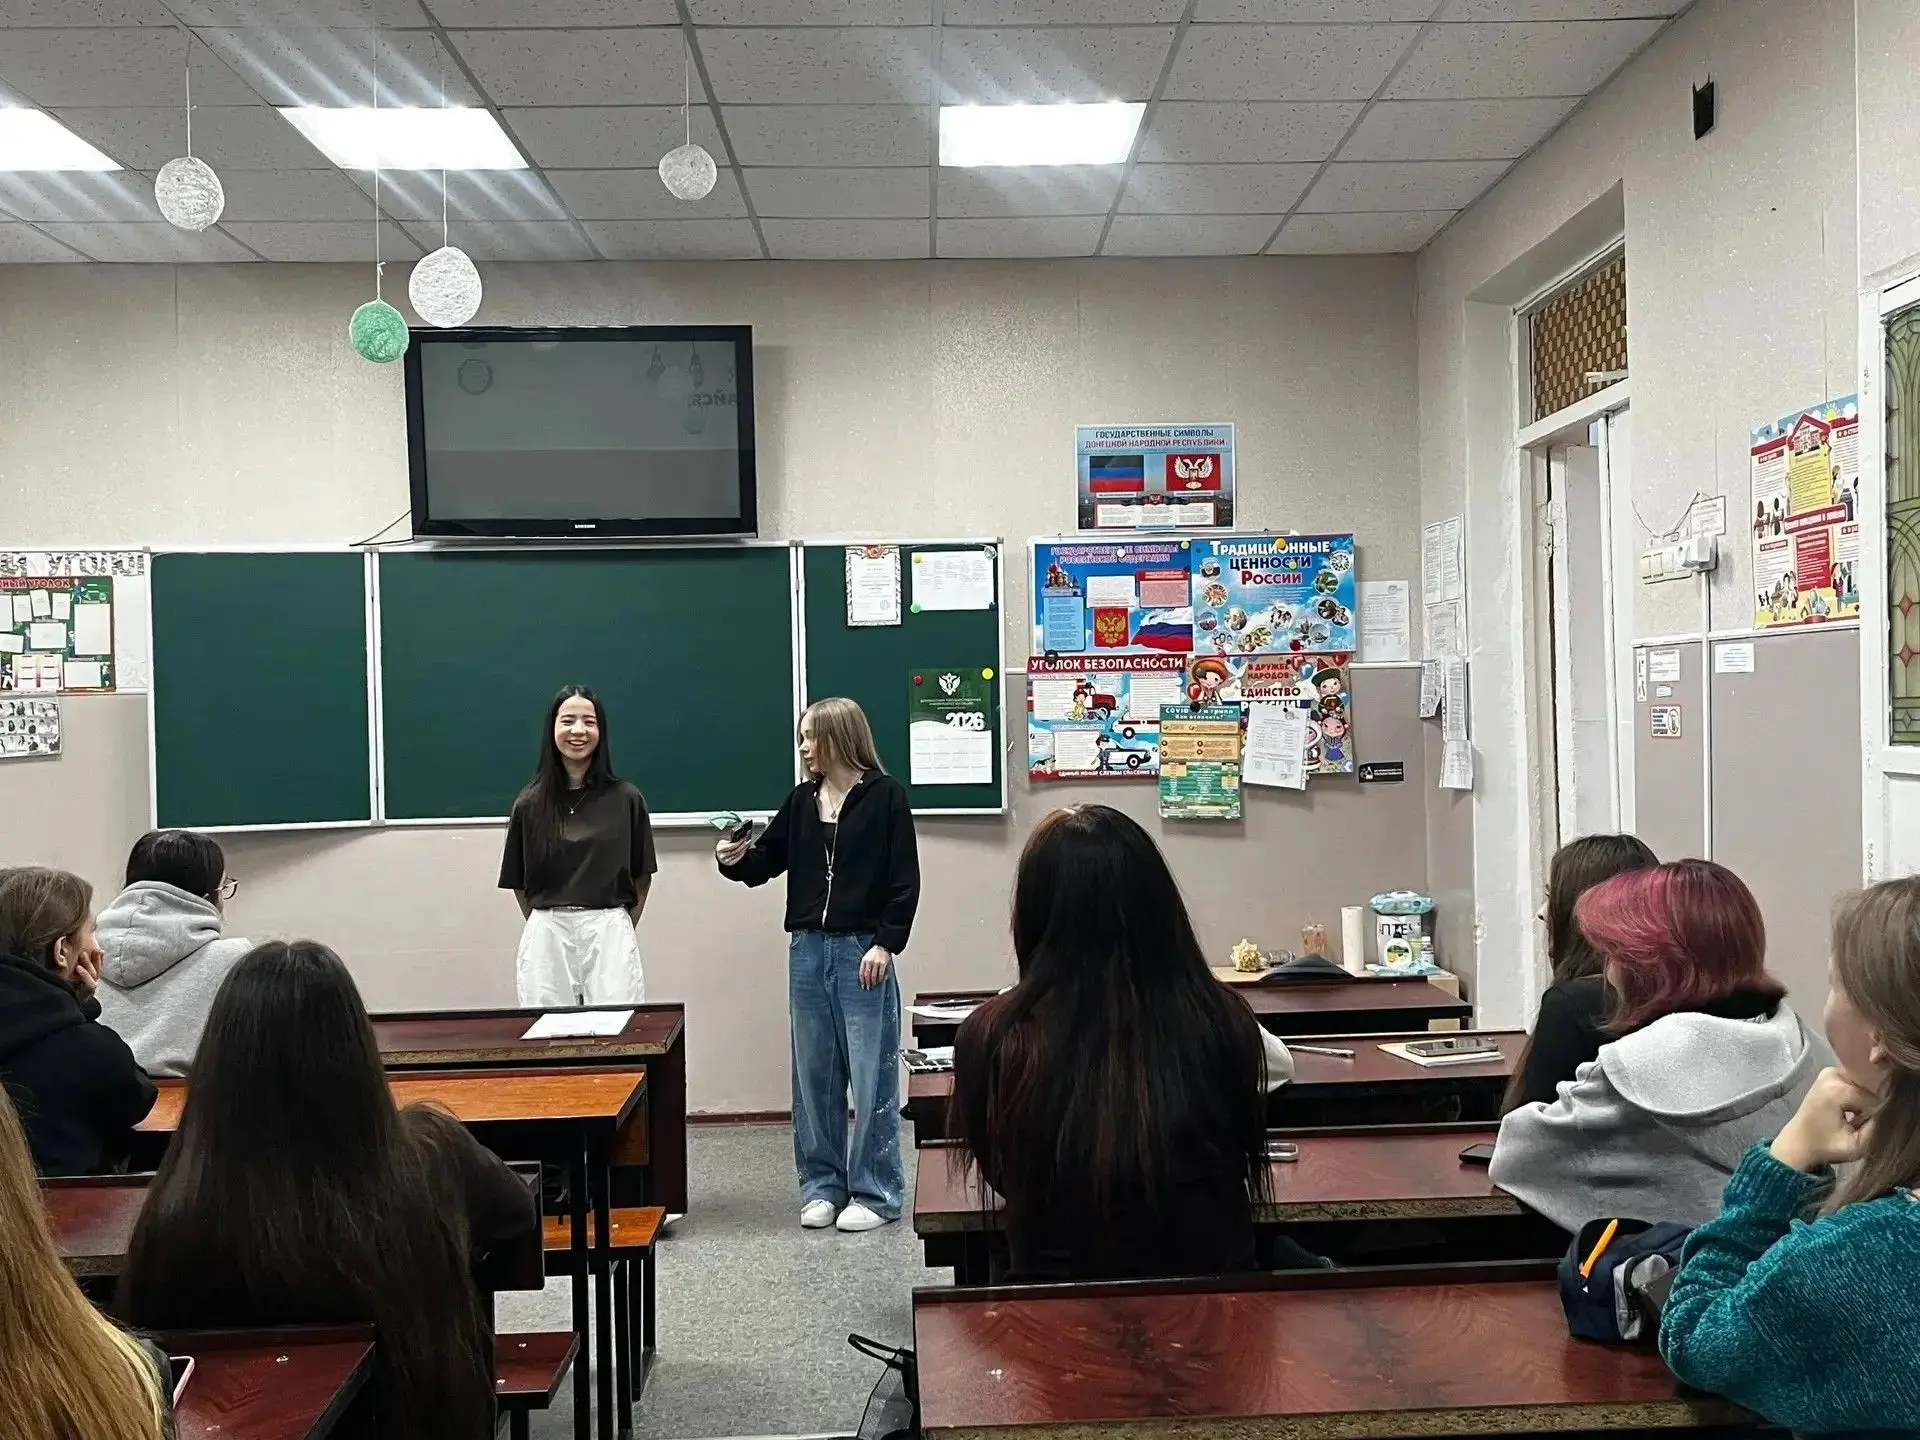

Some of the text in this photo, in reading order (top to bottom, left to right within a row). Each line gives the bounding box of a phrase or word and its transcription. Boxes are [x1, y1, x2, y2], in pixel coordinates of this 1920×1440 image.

[1095, 429, 1214, 439] ГОСУДАРСТВЕННЫЕ СИМВОЛЫ
[1085, 438, 1225, 449] ДОНЕЦКОЙ НАРОДНОЙ РЕСПУБЛИКИ
[1229, 556, 1312, 571] ЦЕННОСТИ
[0, 578, 71, 588] НЫЙ УГОЛОК
[1241, 570, 1302, 585] РОССИИ
[1084, 657, 1183, 670] БЕЗОПАСНОСТИ
[1255, 663, 1290, 671] ДРУЖБЕ
[1241, 687, 1301, 699] ЕДИНСТВО
[945, 711, 985, 731] 2026
